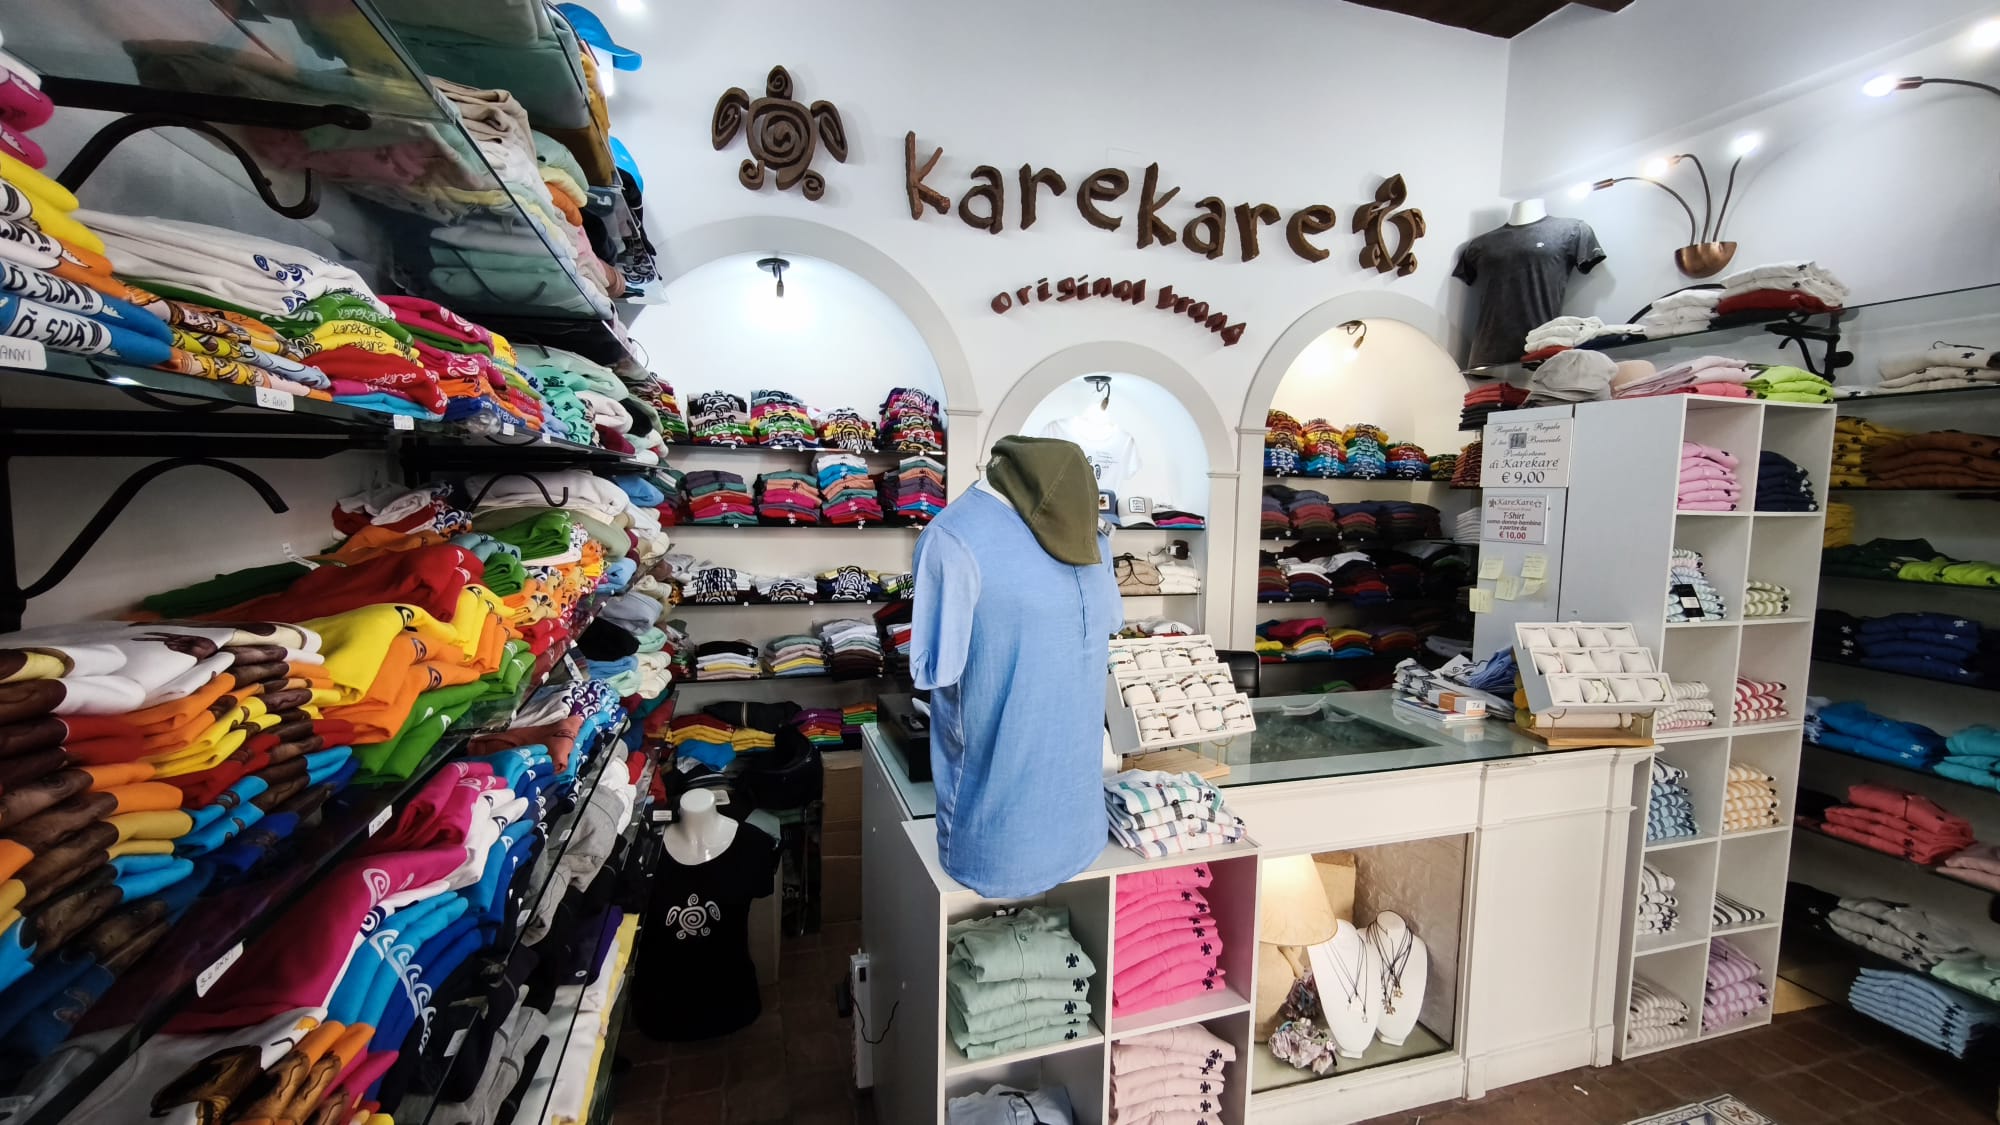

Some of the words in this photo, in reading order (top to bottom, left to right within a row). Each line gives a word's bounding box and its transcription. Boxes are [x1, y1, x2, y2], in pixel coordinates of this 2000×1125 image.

[905, 131, 1337, 263] karekare
[991, 274, 1146, 315] original
[1502, 472, 1510, 483] €
[1514, 470, 1545, 485] 9,00
[1503, 511, 1525, 520] T-Shirt
[1506, 531, 1527, 541] 10,00
